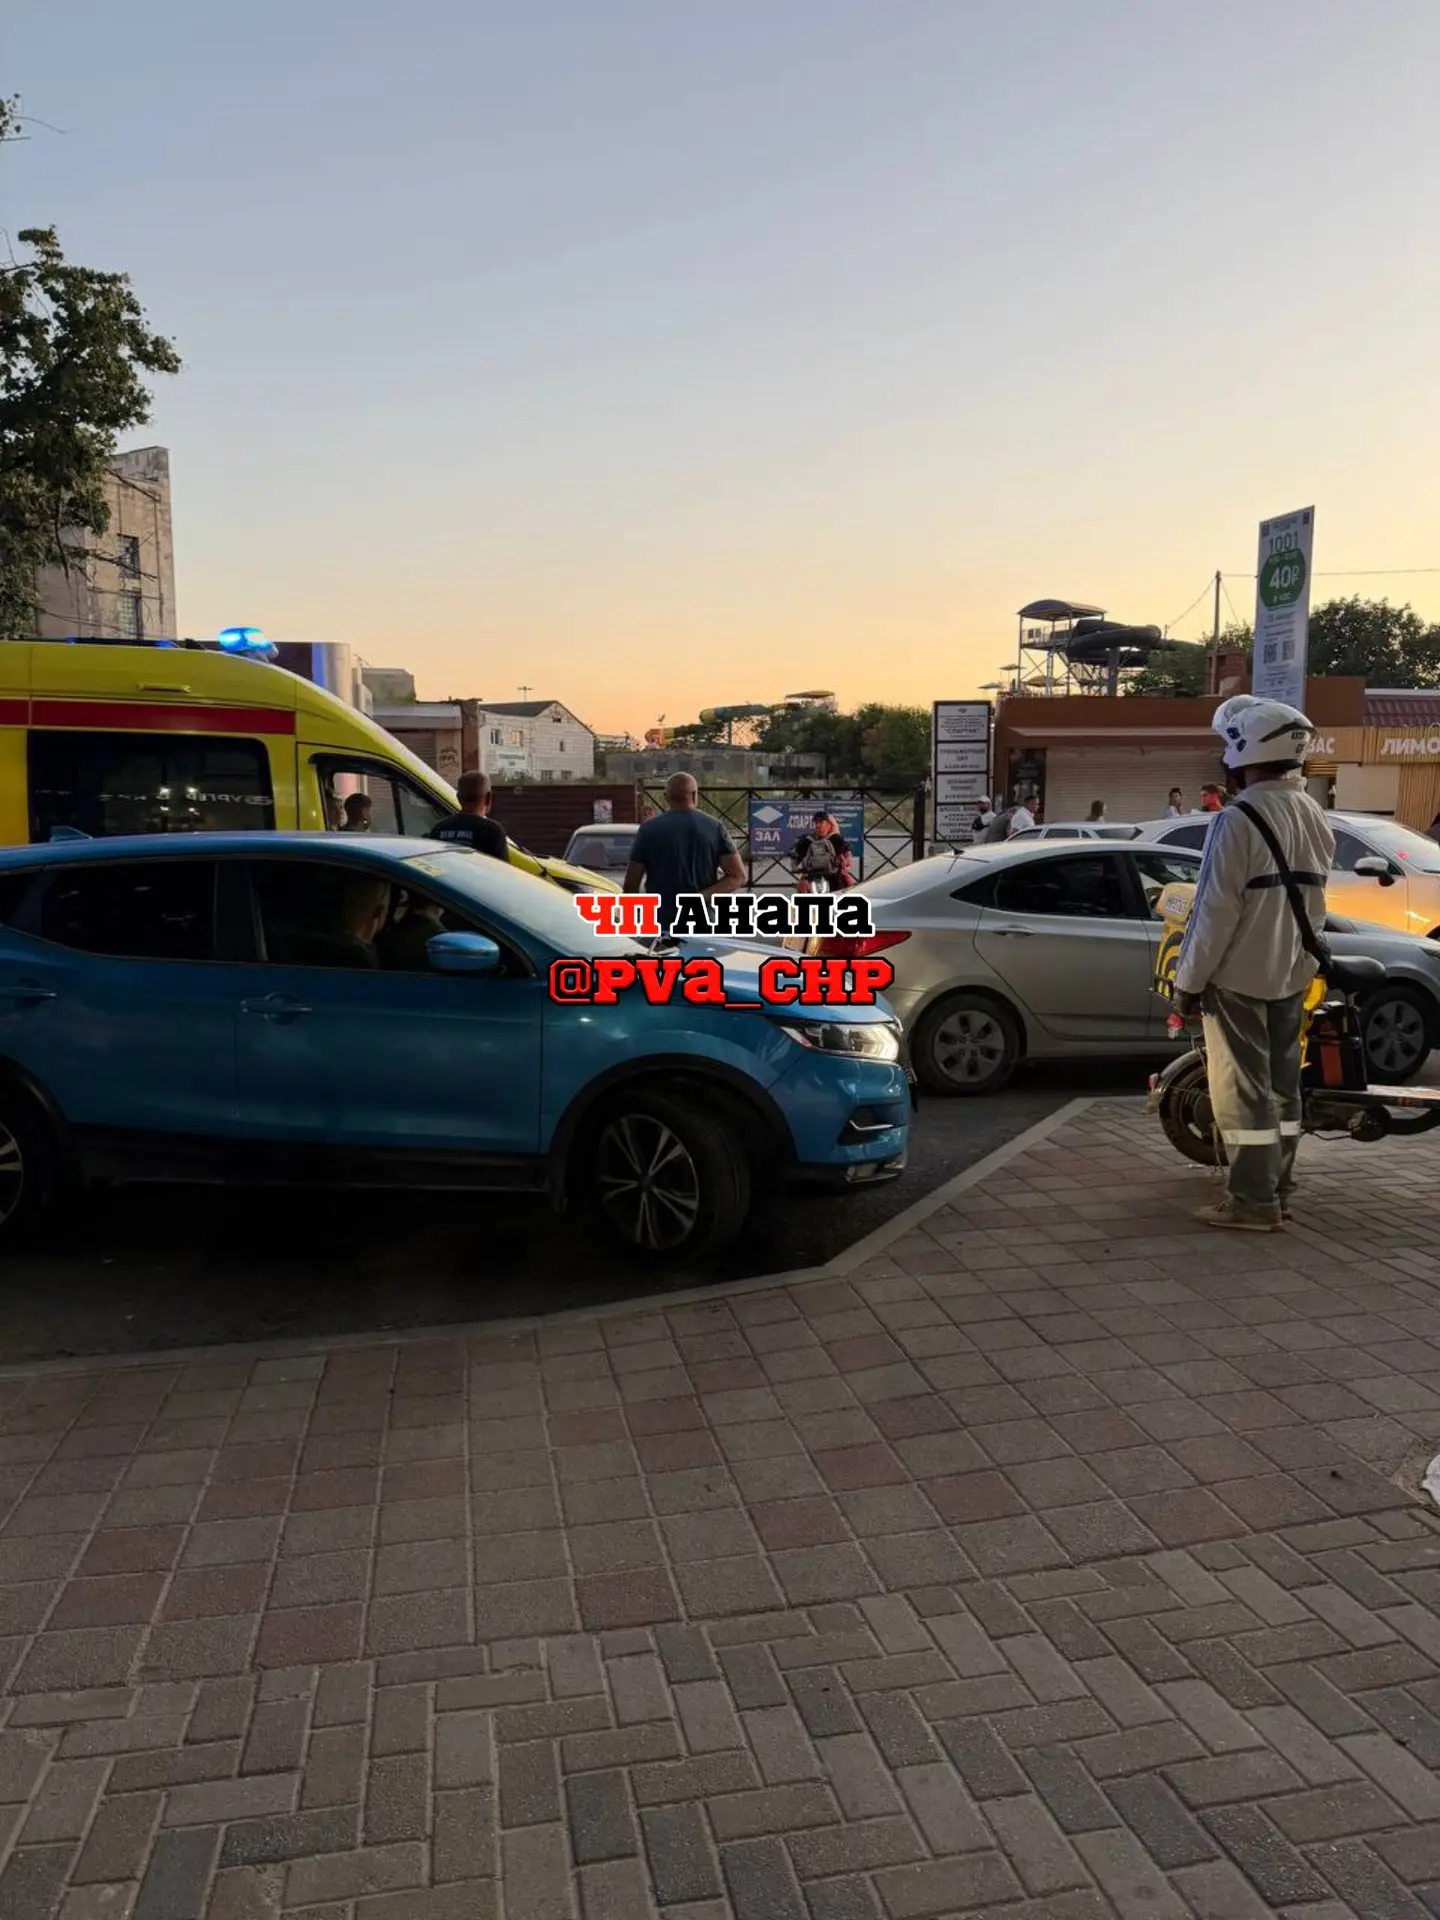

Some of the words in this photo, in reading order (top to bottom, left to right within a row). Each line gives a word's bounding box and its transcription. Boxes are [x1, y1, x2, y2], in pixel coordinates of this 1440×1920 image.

[1269, 530, 1298, 555] 1001
[1306, 737, 1335, 756] ВАС
[755, 830, 781, 842] ЗАЛ
